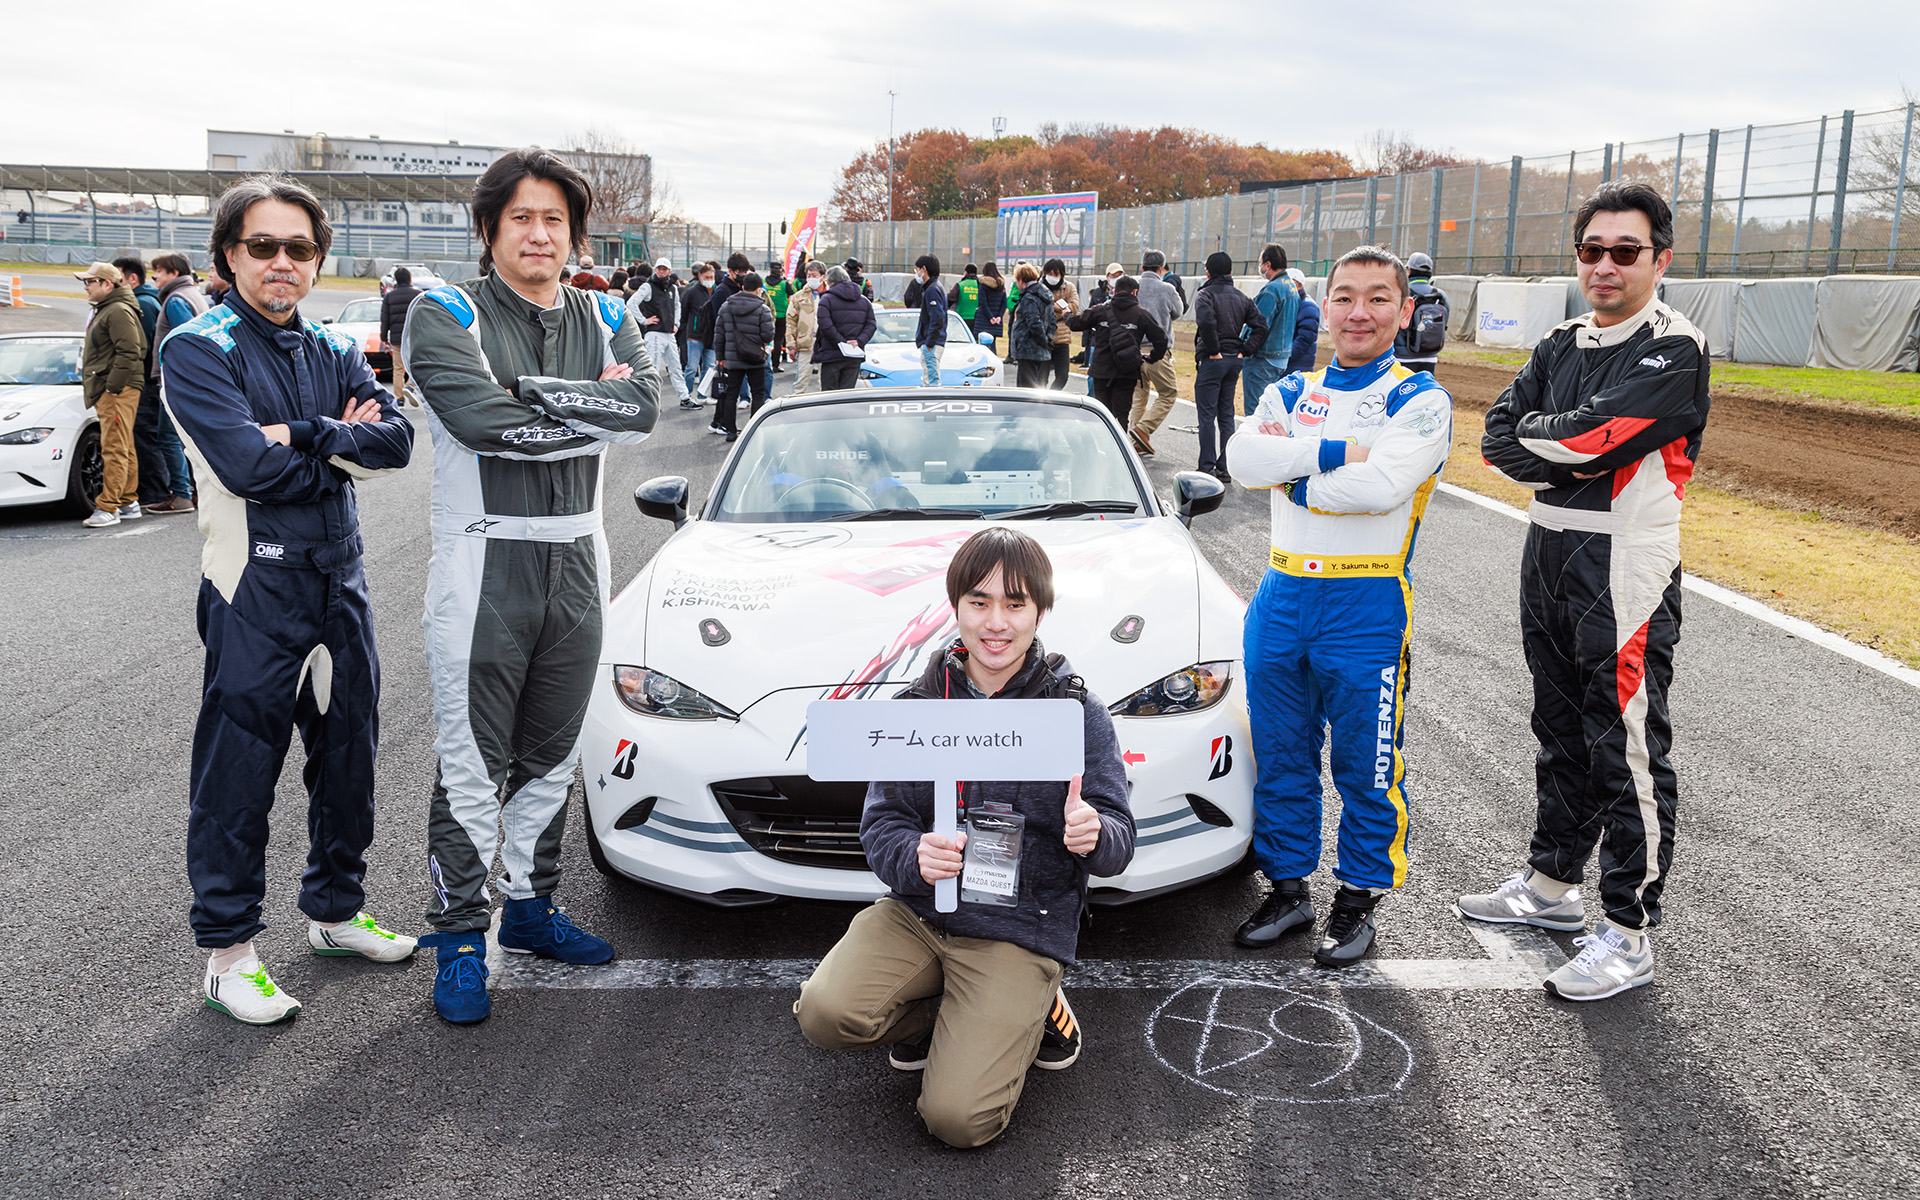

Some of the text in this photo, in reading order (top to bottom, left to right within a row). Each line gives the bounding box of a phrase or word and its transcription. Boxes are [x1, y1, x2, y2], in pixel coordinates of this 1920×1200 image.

[543, 391, 641, 416] alpinestars
[869, 402, 993, 415] mazda
[815, 450, 868, 460] BRIDE
[255, 545, 284, 557] OMP
[666, 587, 777, 602] K.OKAMOTO
[661, 597, 772, 611] K.ISHIKAWA
[1374, 664, 1396, 789] POTENZA
[868, 730, 1023, 747] チーム car watch
[984, 870, 1007, 878] mazda
[966, 876, 1012, 890] MAZDA GUEST
